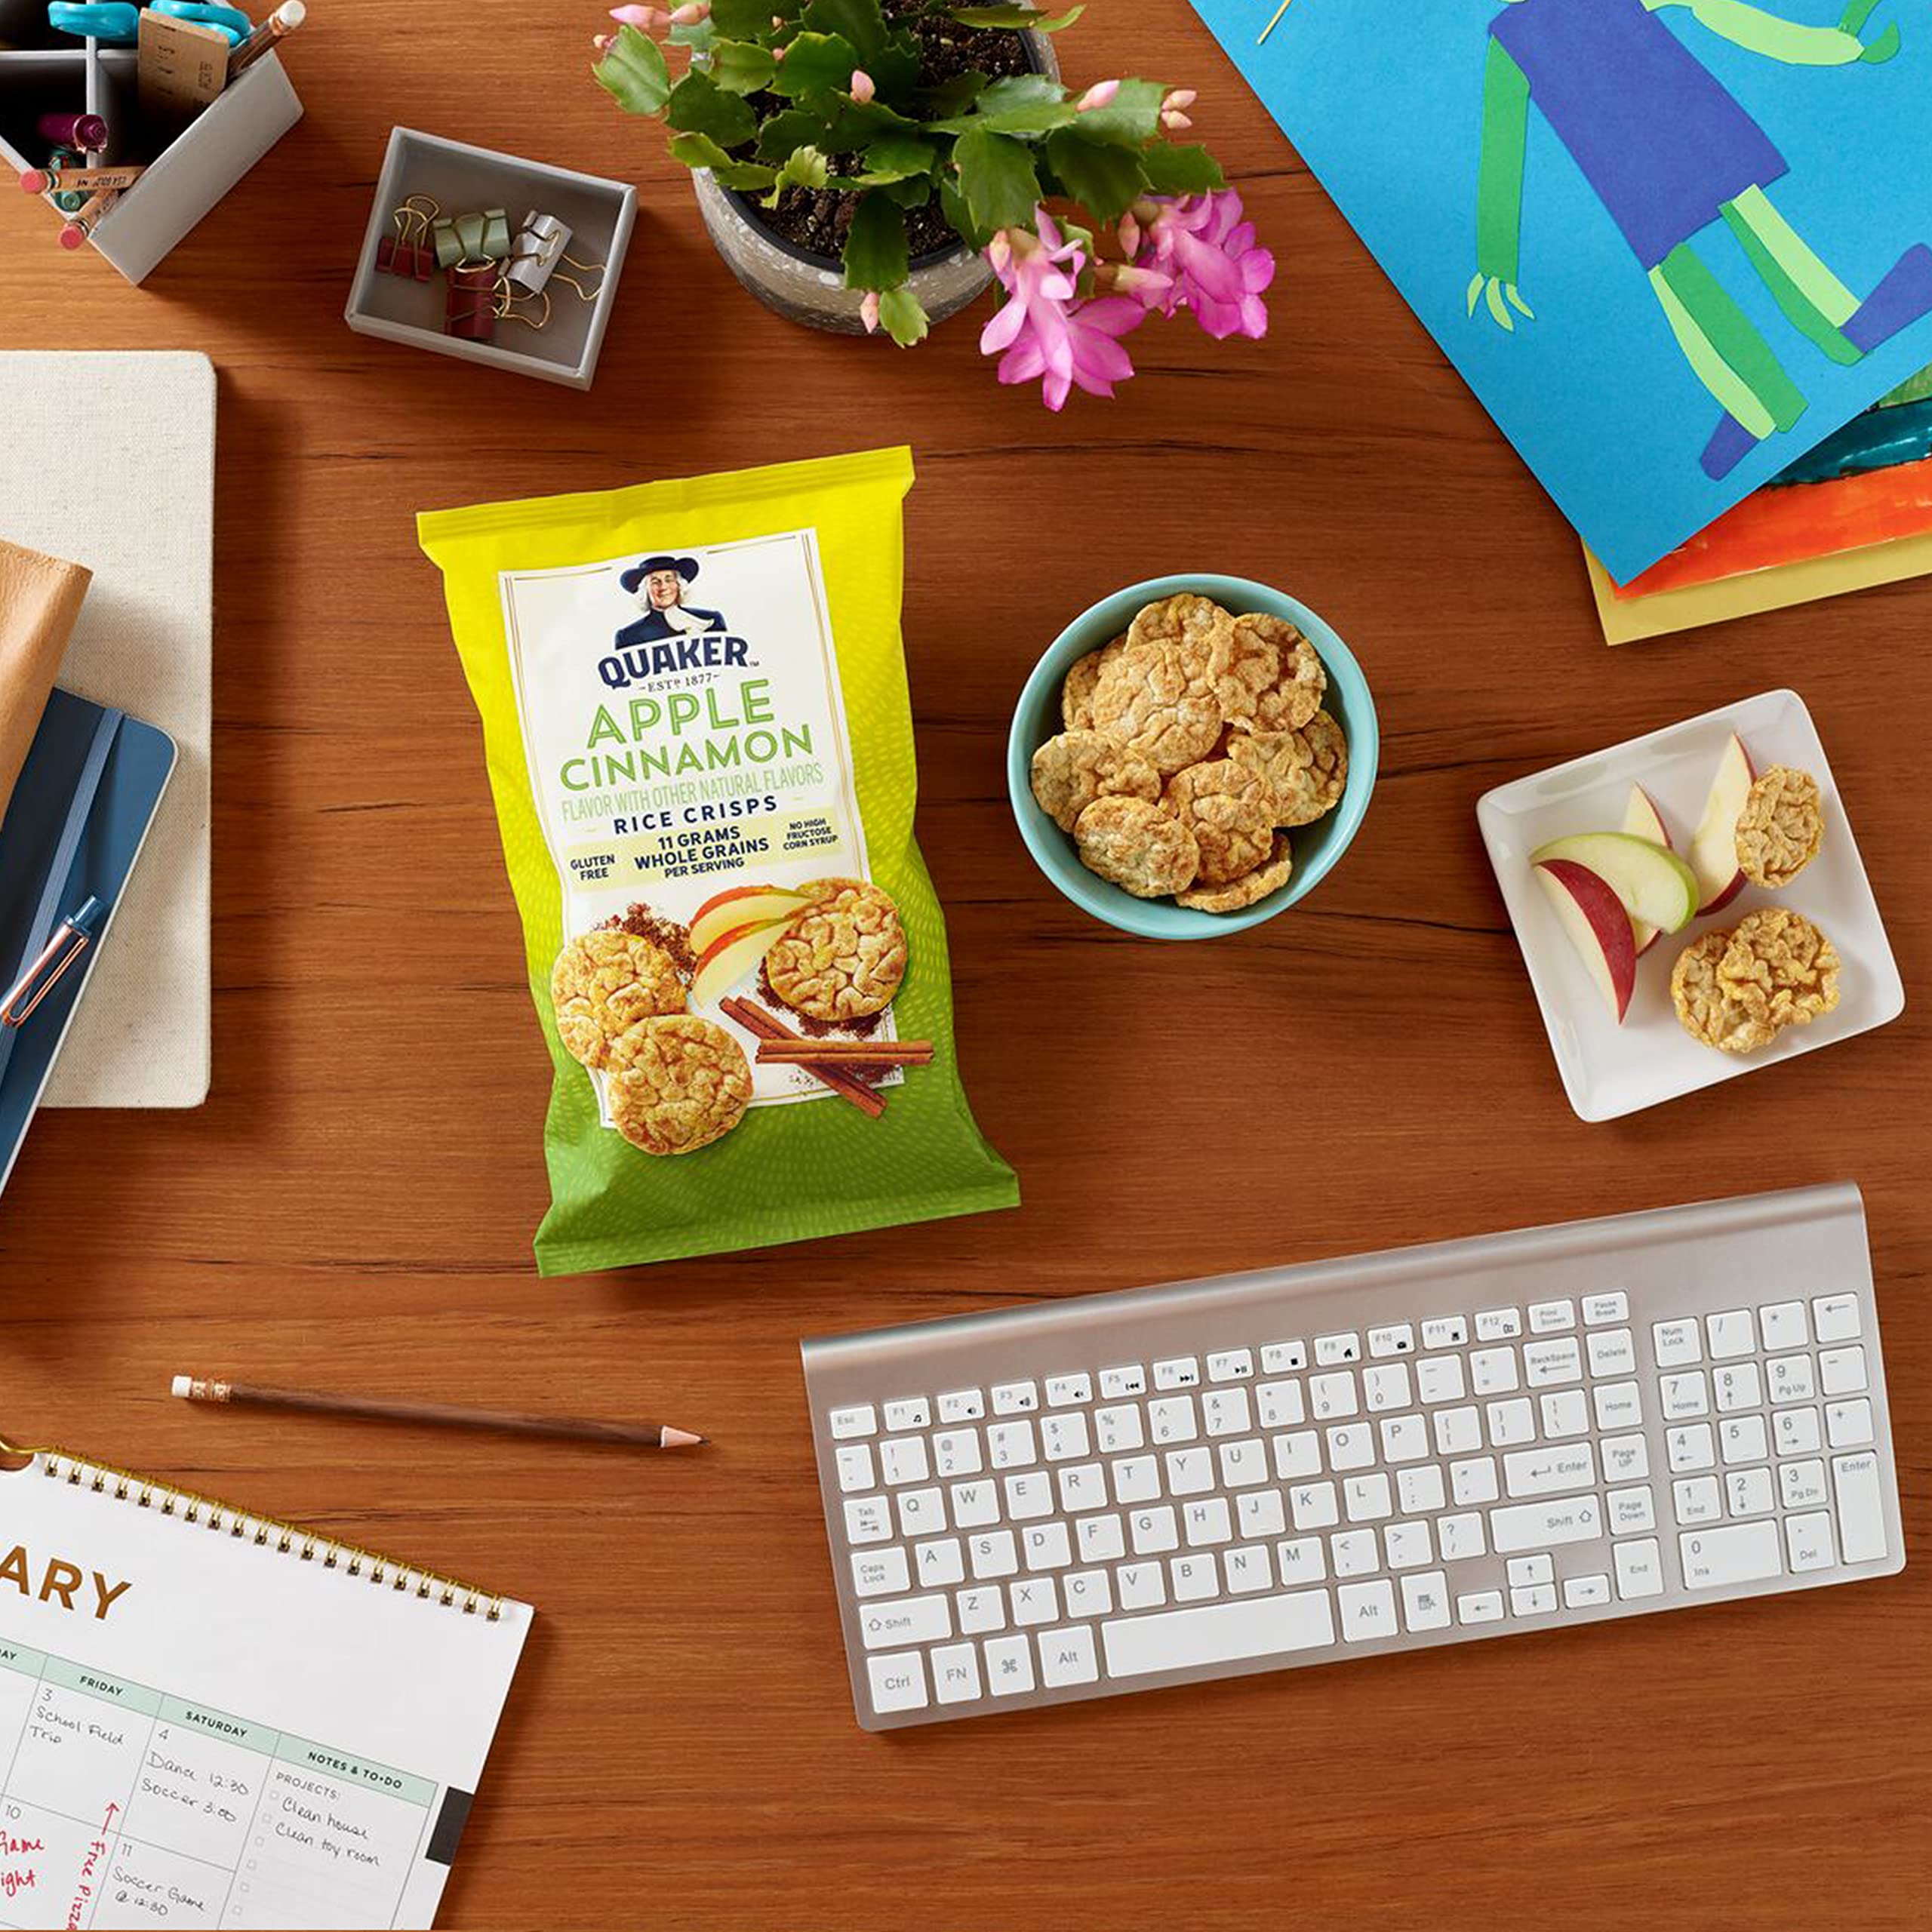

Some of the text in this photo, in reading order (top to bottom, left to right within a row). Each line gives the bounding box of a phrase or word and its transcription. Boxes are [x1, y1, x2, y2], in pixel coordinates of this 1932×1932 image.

[598, 636, 749, 690] QUAKER
[586, 678, 774, 749] APPLE
[560, 724, 813, 791] CINNAMON
[561, 761, 823, 823] FLAVOR WITH OTHER NATURAL FLAVORS
[614, 795, 777, 834] RICE CRISPS
[789, 818, 826, 830] NO HIGH
[658, 826, 740, 850] 11 GRAMS
[786, 826, 832, 841] FRUCTOSE
[783, 835, 838, 851] CORN SYRUP
[635, 838, 769, 869] WHOLE GRAINS
[571, 854, 615, 870] GLUTEN
[664, 857, 744, 878] PER SERVING
[580, 868, 609, 881] FREE
[1662, 1327, 1683, 1337] Num
[1663, 1337, 1684, 1347] Lock
[1597, 1348, 1626, 1359] Delete
[1776, 1364, 1786, 1378] 9
[1723, 1373, 1734, 1386] 8
[1670, 1381, 1679, 1395] 7
[1375, 1392, 1383, 1404] 0
[1321, 1401, 1330, 1412] 9
[1604, 1401, 1632, 1411] Home
[1672, 1400, 1700, 1411] Home
[1269, 1409, 1276, 1420] 8
[1214, 1418, 1222, 1429] 7
[1783, 1417, 1792, 1430] 6
[1161, 1426, 1169, 1437] 6
[1391, 1425, 1401, 1438] P
[1730, 1425, 1740, 1439] 5
[1108, 1435, 1115, 1445] 5
[1336, 1433, 1349, 1447] O
[1677, 1434, 1686, 1447] 4
[1054, 1443, 1061, 1453] 4
[1287, 1441, 1292, 1454] I
[1000, 1451, 1008, 1461] 3
[1230, 1450, 1241, 1463] U
[1612, 1449, 1636, 1460] Page
[946, 1460, 953, 1469] 2
[1176, 1457, 1186, 1471] Y
[1557, 1461, 1587, 1473] Enter
[1841, 1460, 1872, 1472] Enter
[894, 1468, 899, 1477] 1
[1124, 1466, 1133, 1479] T
[1789, 1469, 1798, 1482] 3
[1068, 1475, 1080, 1487] R
[1737, 1478, 1746, 1491] 2
[1016, 1482, 1026, 1495] E
[1356, 1484, 1366, 1498] L
[1684, 1487, 1692, 1499] 1
[960, 1490, 976, 1503] W
[1300, 1492, 1312, 1506] K
[906, 1498, 919, 1512] Q
[1251, 1501, 1259, 1513] J
[1619, 1502, 1642, 1512] Page
[1193, 1509, 1206, 1522] H
[1620, 1511, 1646, 1521] Down
[1140, 1517, 1152, 1531] G
[1547, 1516, 1574, 1529] Shift
[1088, 1524, 1097, 1538] F
[1033, 1534, 1044, 1546] D
[980, 1541, 991, 1555] S
[1691, 1540, 1701, 1554] 0
[925, 1549, 937, 1564] A
[1286, 1548, 1300, 1561] M
[1800, 1550, 1817, 1560] Del
[1234, 1555, 1246, 1569] N
[1181, 1564, 1192, 1577] B
[0, 1546, 132, 1620] ARY
[863, 1574, 885, 1583] Lock
[1125, 1573, 1137, 1586] V
[1073, 1580, 1085, 1594] C
[1020, 1589, 1032, 1602] X
[968, 1596, 978, 1611] Z
[1358, 1604, 1378, 1618] Alt
[885, 1617, 912, 1629] Shift
[0, 1648, 17, 1660] AY
[1059, 1651, 1078, 1664] Alt
[946, 1667, 967, 1681] FN
[80, 1675, 123, 1697] FRIDAY
[884, 1675, 909, 1690] Ctrl
[42, 1688, 52, 1701] 3
[37, 1705, 123, 1745] School Field
[186, 1711, 248, 1737] SATURDAY
[29, 1725, 62, 1743] Trip
[158, 1730, 168, 1740] 4
[308, 1752, 347, 1770] NOTES
[350, 1767, 358, 1775] &
[146, 1751, 249, 1795] Dance 12:30
[142, 1778, 198, 1806] Soccer
[6, 1804, 21, 1820] 10
[282, 1796, 368, 1840] Clean house
[122, 1843, 132, 1857] 11
[275, 1823, 380, 1867] Clean toy room
[82, 1841, 105, 1876] Free
[113, 1866, 205, 1912] Soccer Game
[134, 1897, 168, 1915] 12:30
